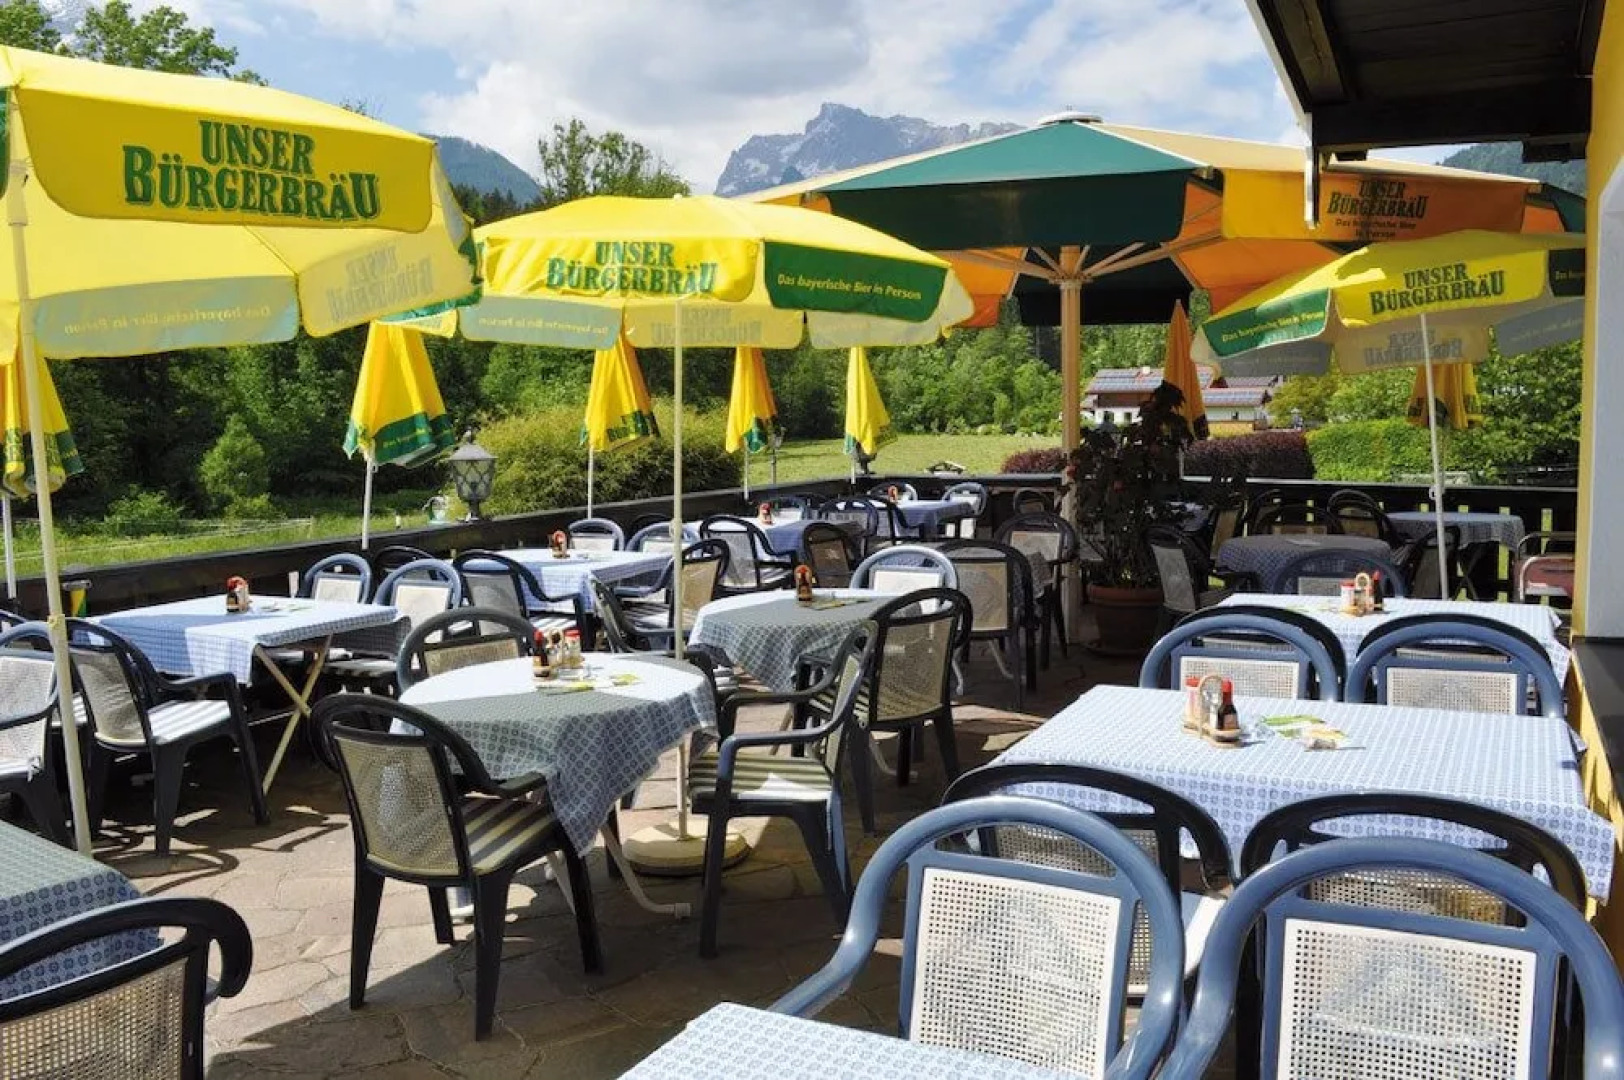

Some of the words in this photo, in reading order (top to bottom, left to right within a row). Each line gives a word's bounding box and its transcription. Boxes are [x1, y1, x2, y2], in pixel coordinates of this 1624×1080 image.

[198, 119, 315, 175] UNSER
[122, 144, 381, 220] BÜRGERBRÄU
[1359, 180, 1406, 198] UNSER
[1327, 192, 1429, 218] BÜRGERBRÄU
[595, 241, 676, 267] UNSER
[546, 257, 718, 295] BÜRGERBRÄU
[777, 273, 795, 286] Das
[797, 274, 852, 292] bayerische
[853, 281, 873, 293] Bier
[873, 282, 883, 295] in
[884, 285, 922, 300] Person
[1404, 262, 1468, 289] UNSER
[1369, 270, 1505, 315] BÜRGERBRÄU
